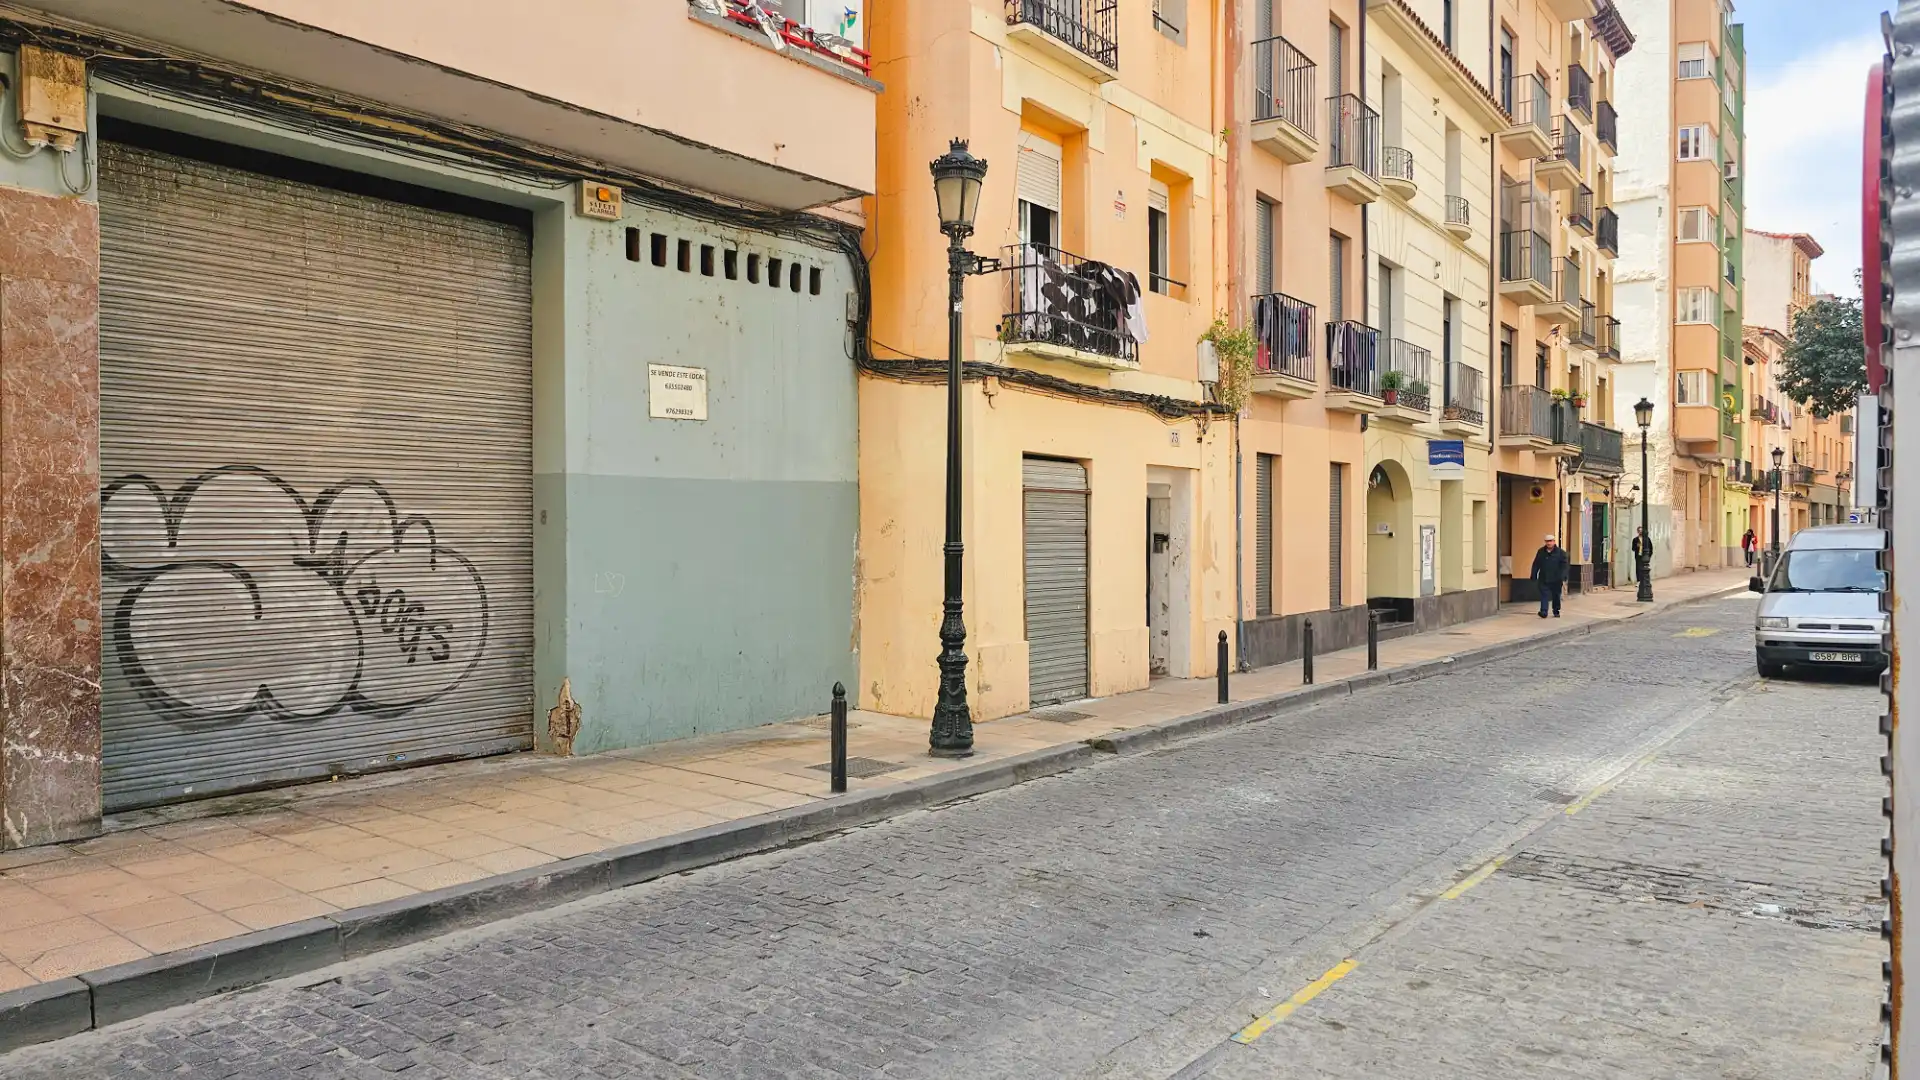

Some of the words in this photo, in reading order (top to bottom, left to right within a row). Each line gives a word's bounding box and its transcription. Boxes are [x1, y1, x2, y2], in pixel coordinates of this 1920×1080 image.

[658, 370, 676, 378] VENDE
[677, 371, 689, 379] ESTE
[689, 373, 705, 381] LOCAL
[1815, 652, 1837, 661] 6587
[1841, 653, 1859, 662] BRP
